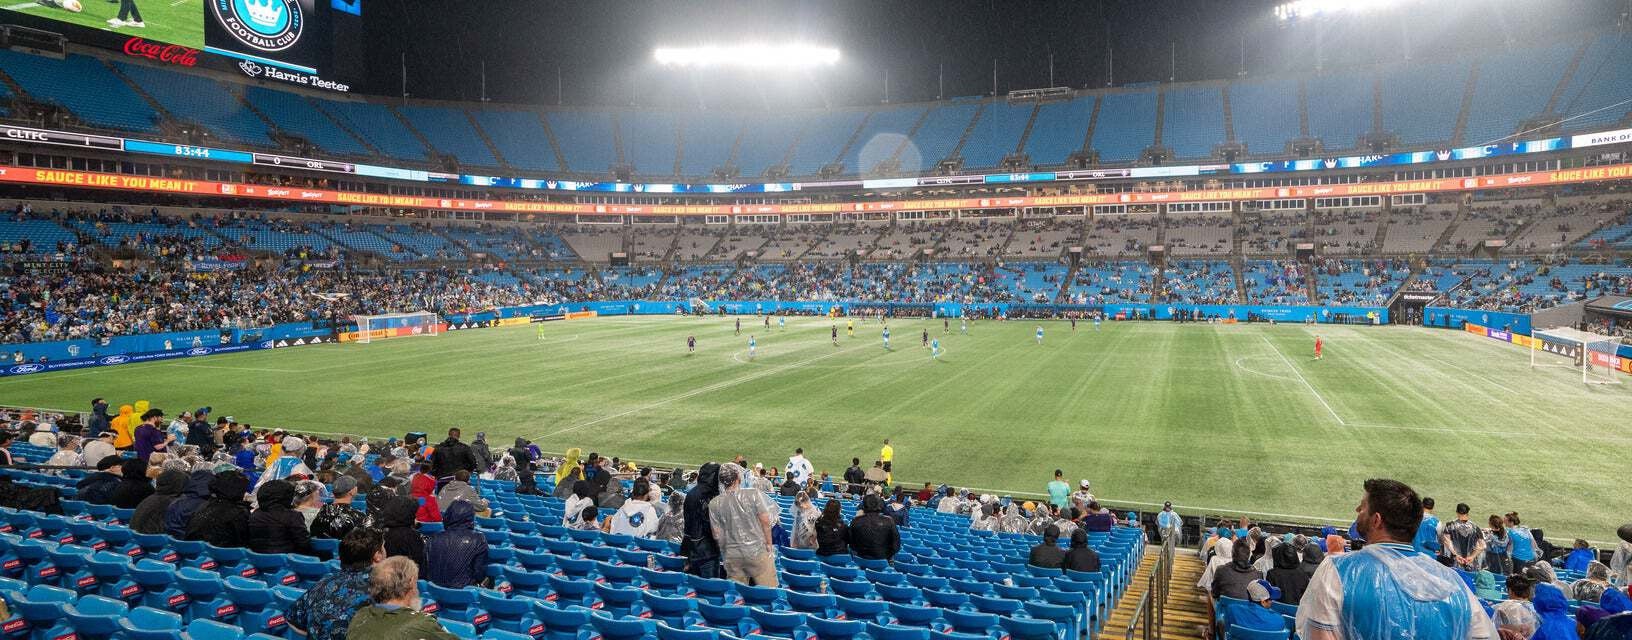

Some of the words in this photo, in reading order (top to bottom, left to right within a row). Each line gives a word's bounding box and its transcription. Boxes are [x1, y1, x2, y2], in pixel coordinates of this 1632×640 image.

[227, 17, 275, 47] FOOTBALL
[277, 31, 295, 46] CLUB
[264, 66, 308, 84] Harris
[310, 75, 349, 92] Teeter
[7, 129, 48, 141] CLTFC
[1592, 136, 1617, 144] BANK
[175, 145, 209, 158] 83:44
[273, 157, 280, 165] 0
[306, 161, 323, 169] ORL
[1551, 169, 1581, 181] SAUCE
[1584, 168, 1605, 180] LIKE
[1608, 166, 1625, 178] YOU
[36, 170, 83, 185] SAUCE
[87, 174, 118, 187] LIKE
[122, 177, 147, 188] YOU
[149, 179, 181, 191] MEAN
[183, 180, 197, 192] IT
[105, 356, 124, 364] Ford
[16, 364, 38, 373] Ford
